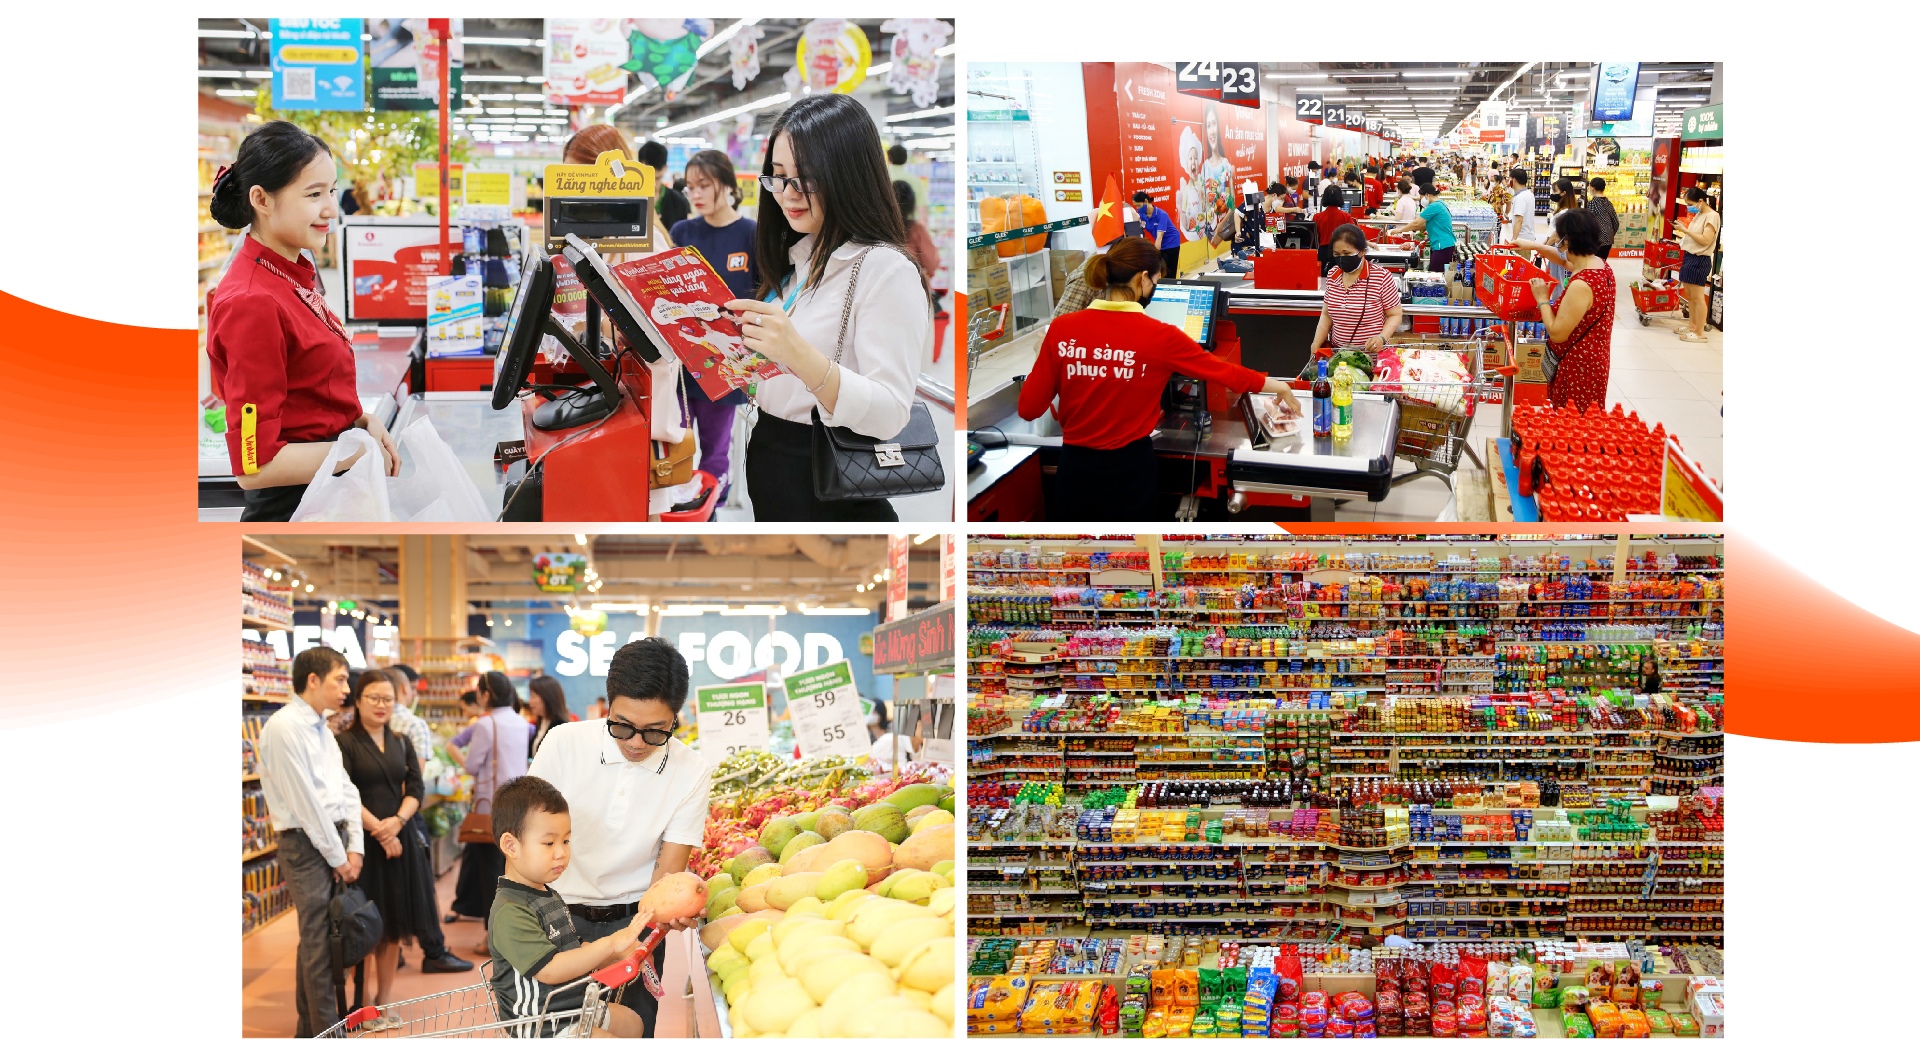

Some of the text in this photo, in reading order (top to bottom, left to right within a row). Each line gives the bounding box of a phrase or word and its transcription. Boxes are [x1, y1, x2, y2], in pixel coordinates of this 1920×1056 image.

[1178, 62, 1219, 82] 24
[1223, 67, 1256, 94] 23
[1298, 99, 1322, 116] 22
[1328, 108, 1345, 122] 21
[1346, 114, 1361, 126] 20
[1700, 112, 1715, 123] 100%
[556, 177, 641, 194] Lắng nghe bạn
[1058, 338, 1136, 367] Sẵn sàng
[1066, 361, 1107, 381] phục
[1113, 367, 1134, 383] vụ
[244, 434, 257, 467] VinMart
[888, 628, 916, 665] Mừng
[918, 616, 945, 657] Sinh
[814, 691, 835, 709] 59
[723, 710, 746, 726] 26
[823, 724, 846, 743] 55
